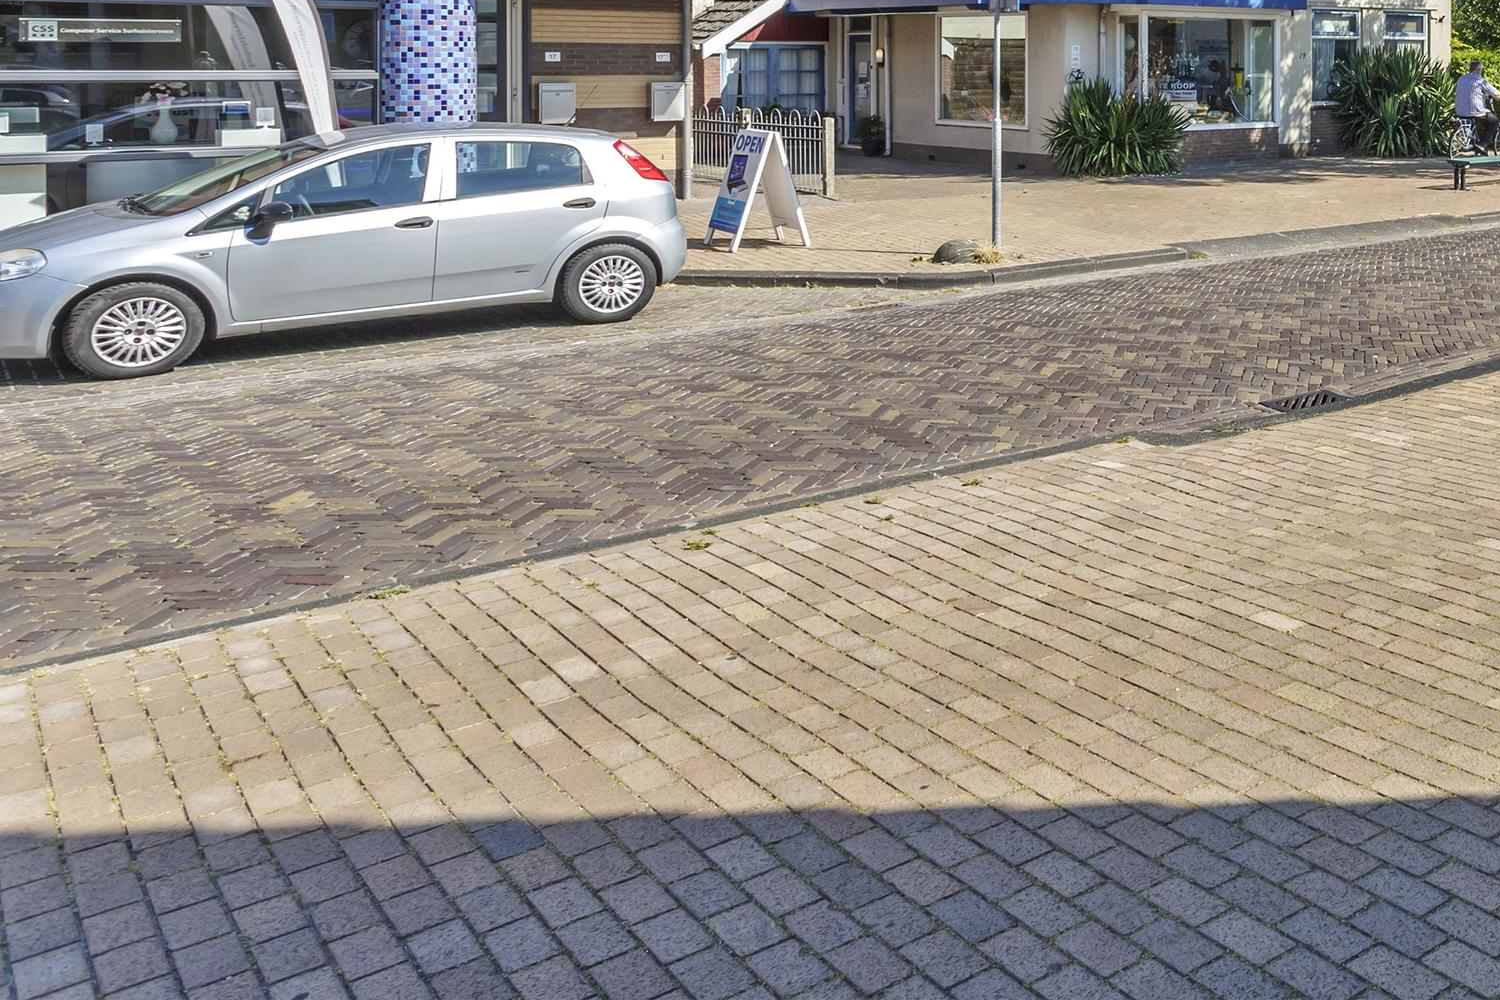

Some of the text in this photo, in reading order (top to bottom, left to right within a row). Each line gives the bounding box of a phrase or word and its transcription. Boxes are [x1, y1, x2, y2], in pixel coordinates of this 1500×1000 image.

[32, 25, 55, 33] CSS
[1170, 82, 1196, 90] KOOP
[735, 134, 766, 155] OPEN
